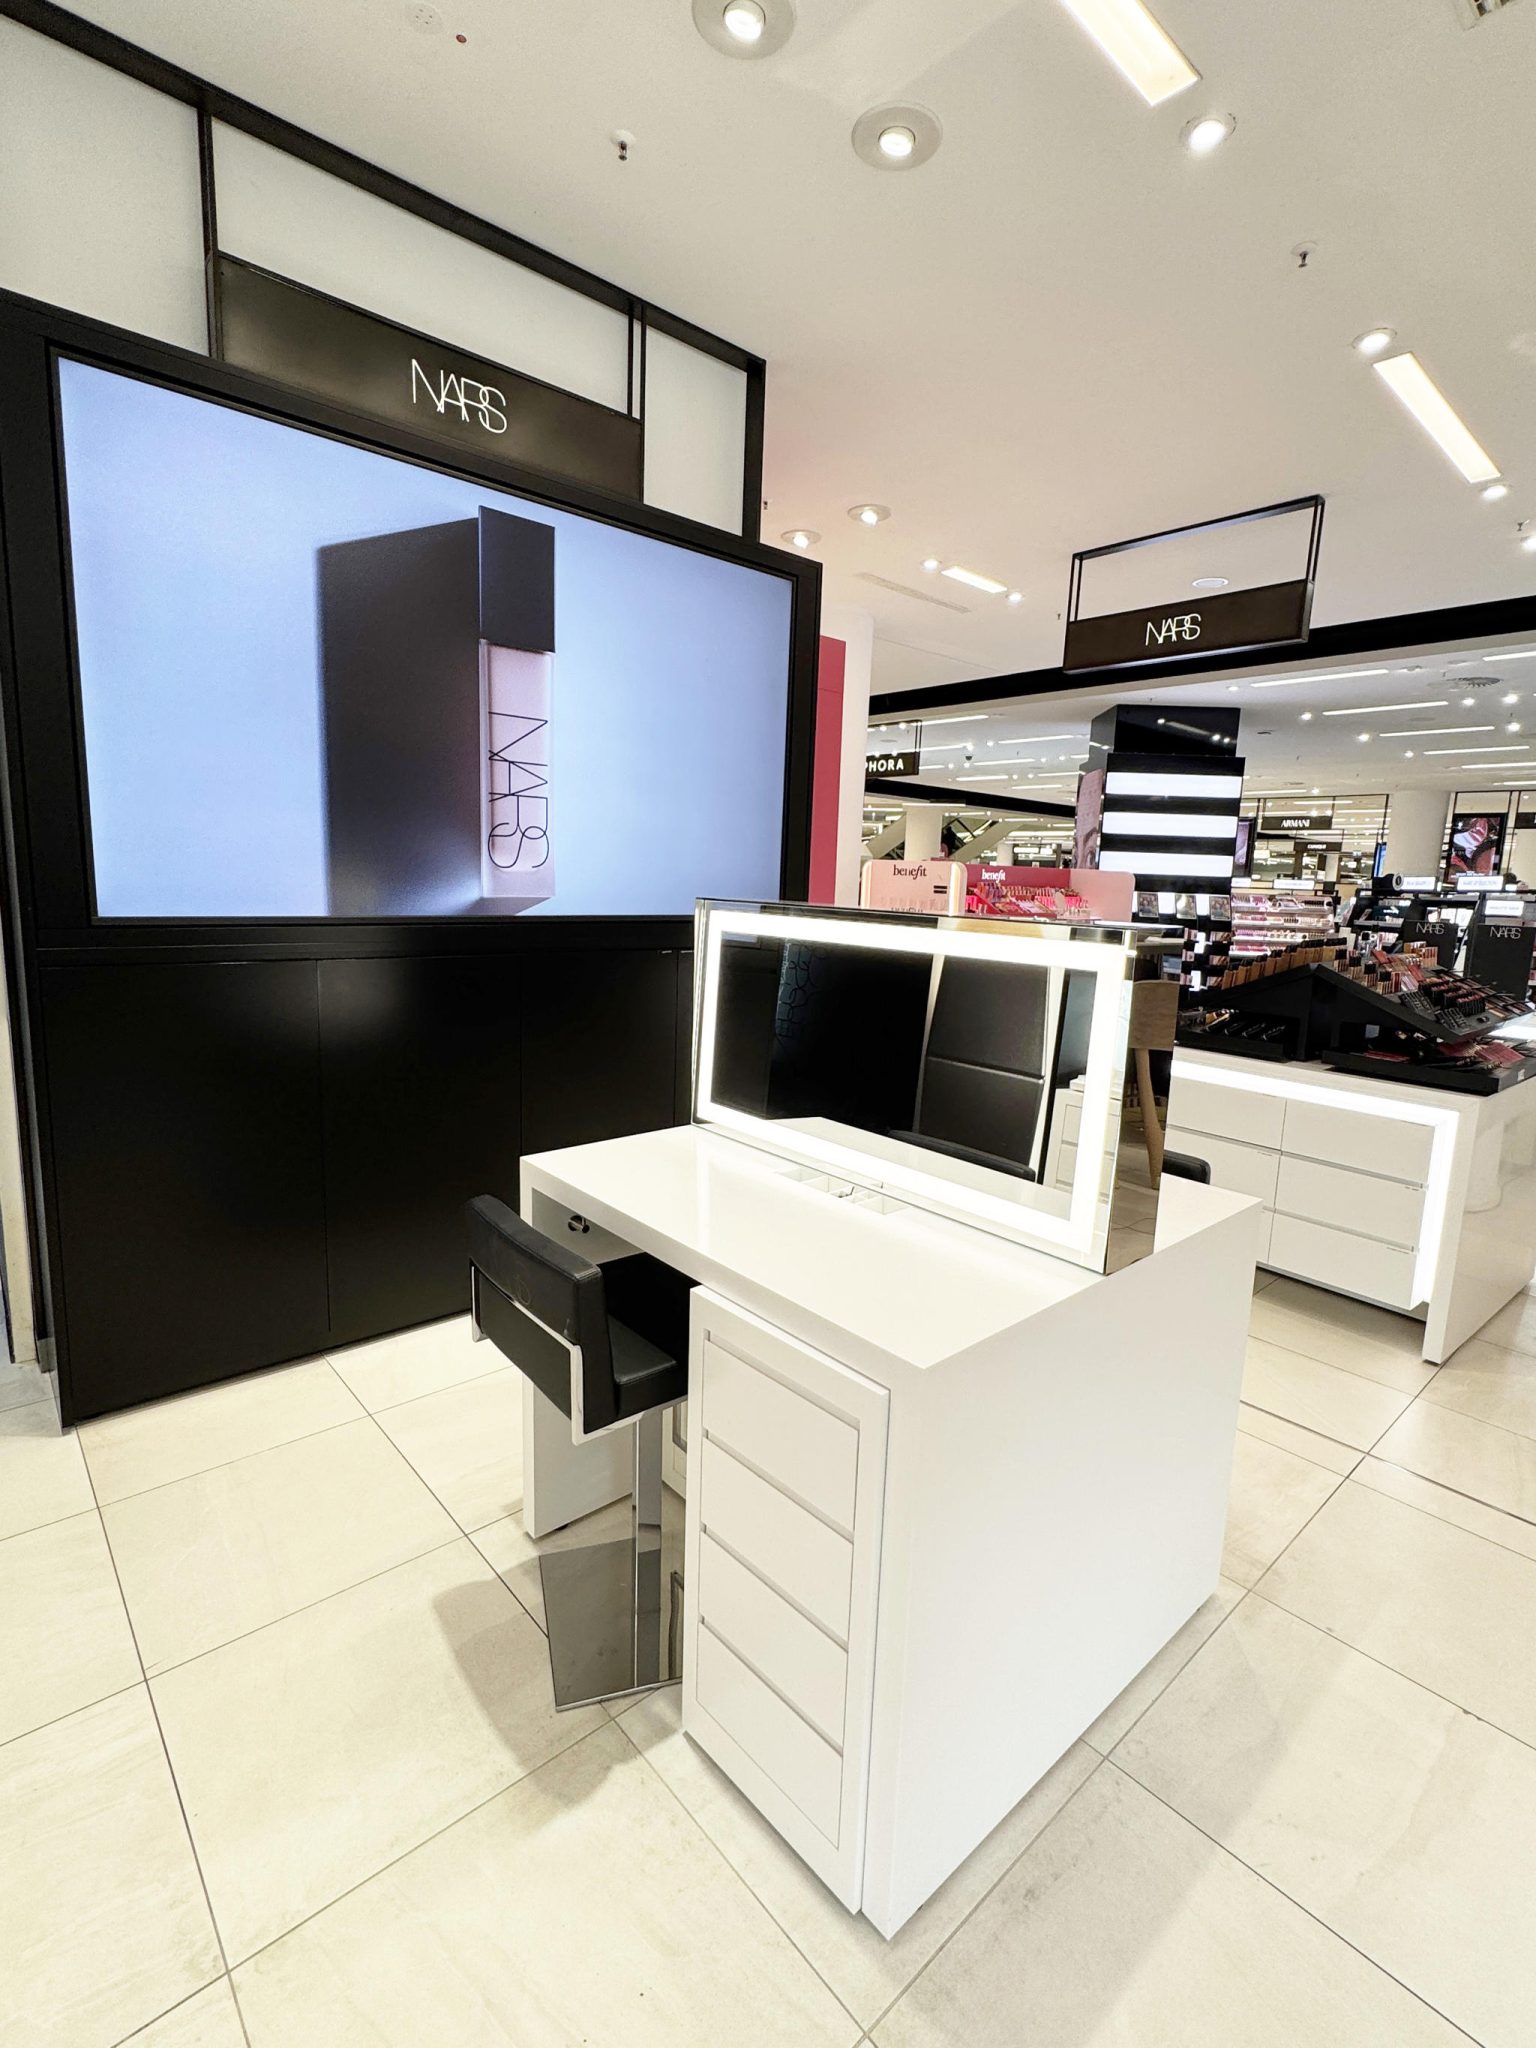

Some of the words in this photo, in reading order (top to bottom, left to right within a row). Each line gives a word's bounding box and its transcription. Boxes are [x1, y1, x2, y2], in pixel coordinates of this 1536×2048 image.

[411, 358, 508, 434] NARS
[1145, 613, 1202, 646] NARS
[488, 711, 549, 868] NARS
[1281, 819, 1311, 828] ARMANI
[893, 864, 927, 879] benefit
[981, 868, 1006, 881] benefit
[1415, 922, 1445, 935] NARS
[1489, 926, 1522, 939] NARS
